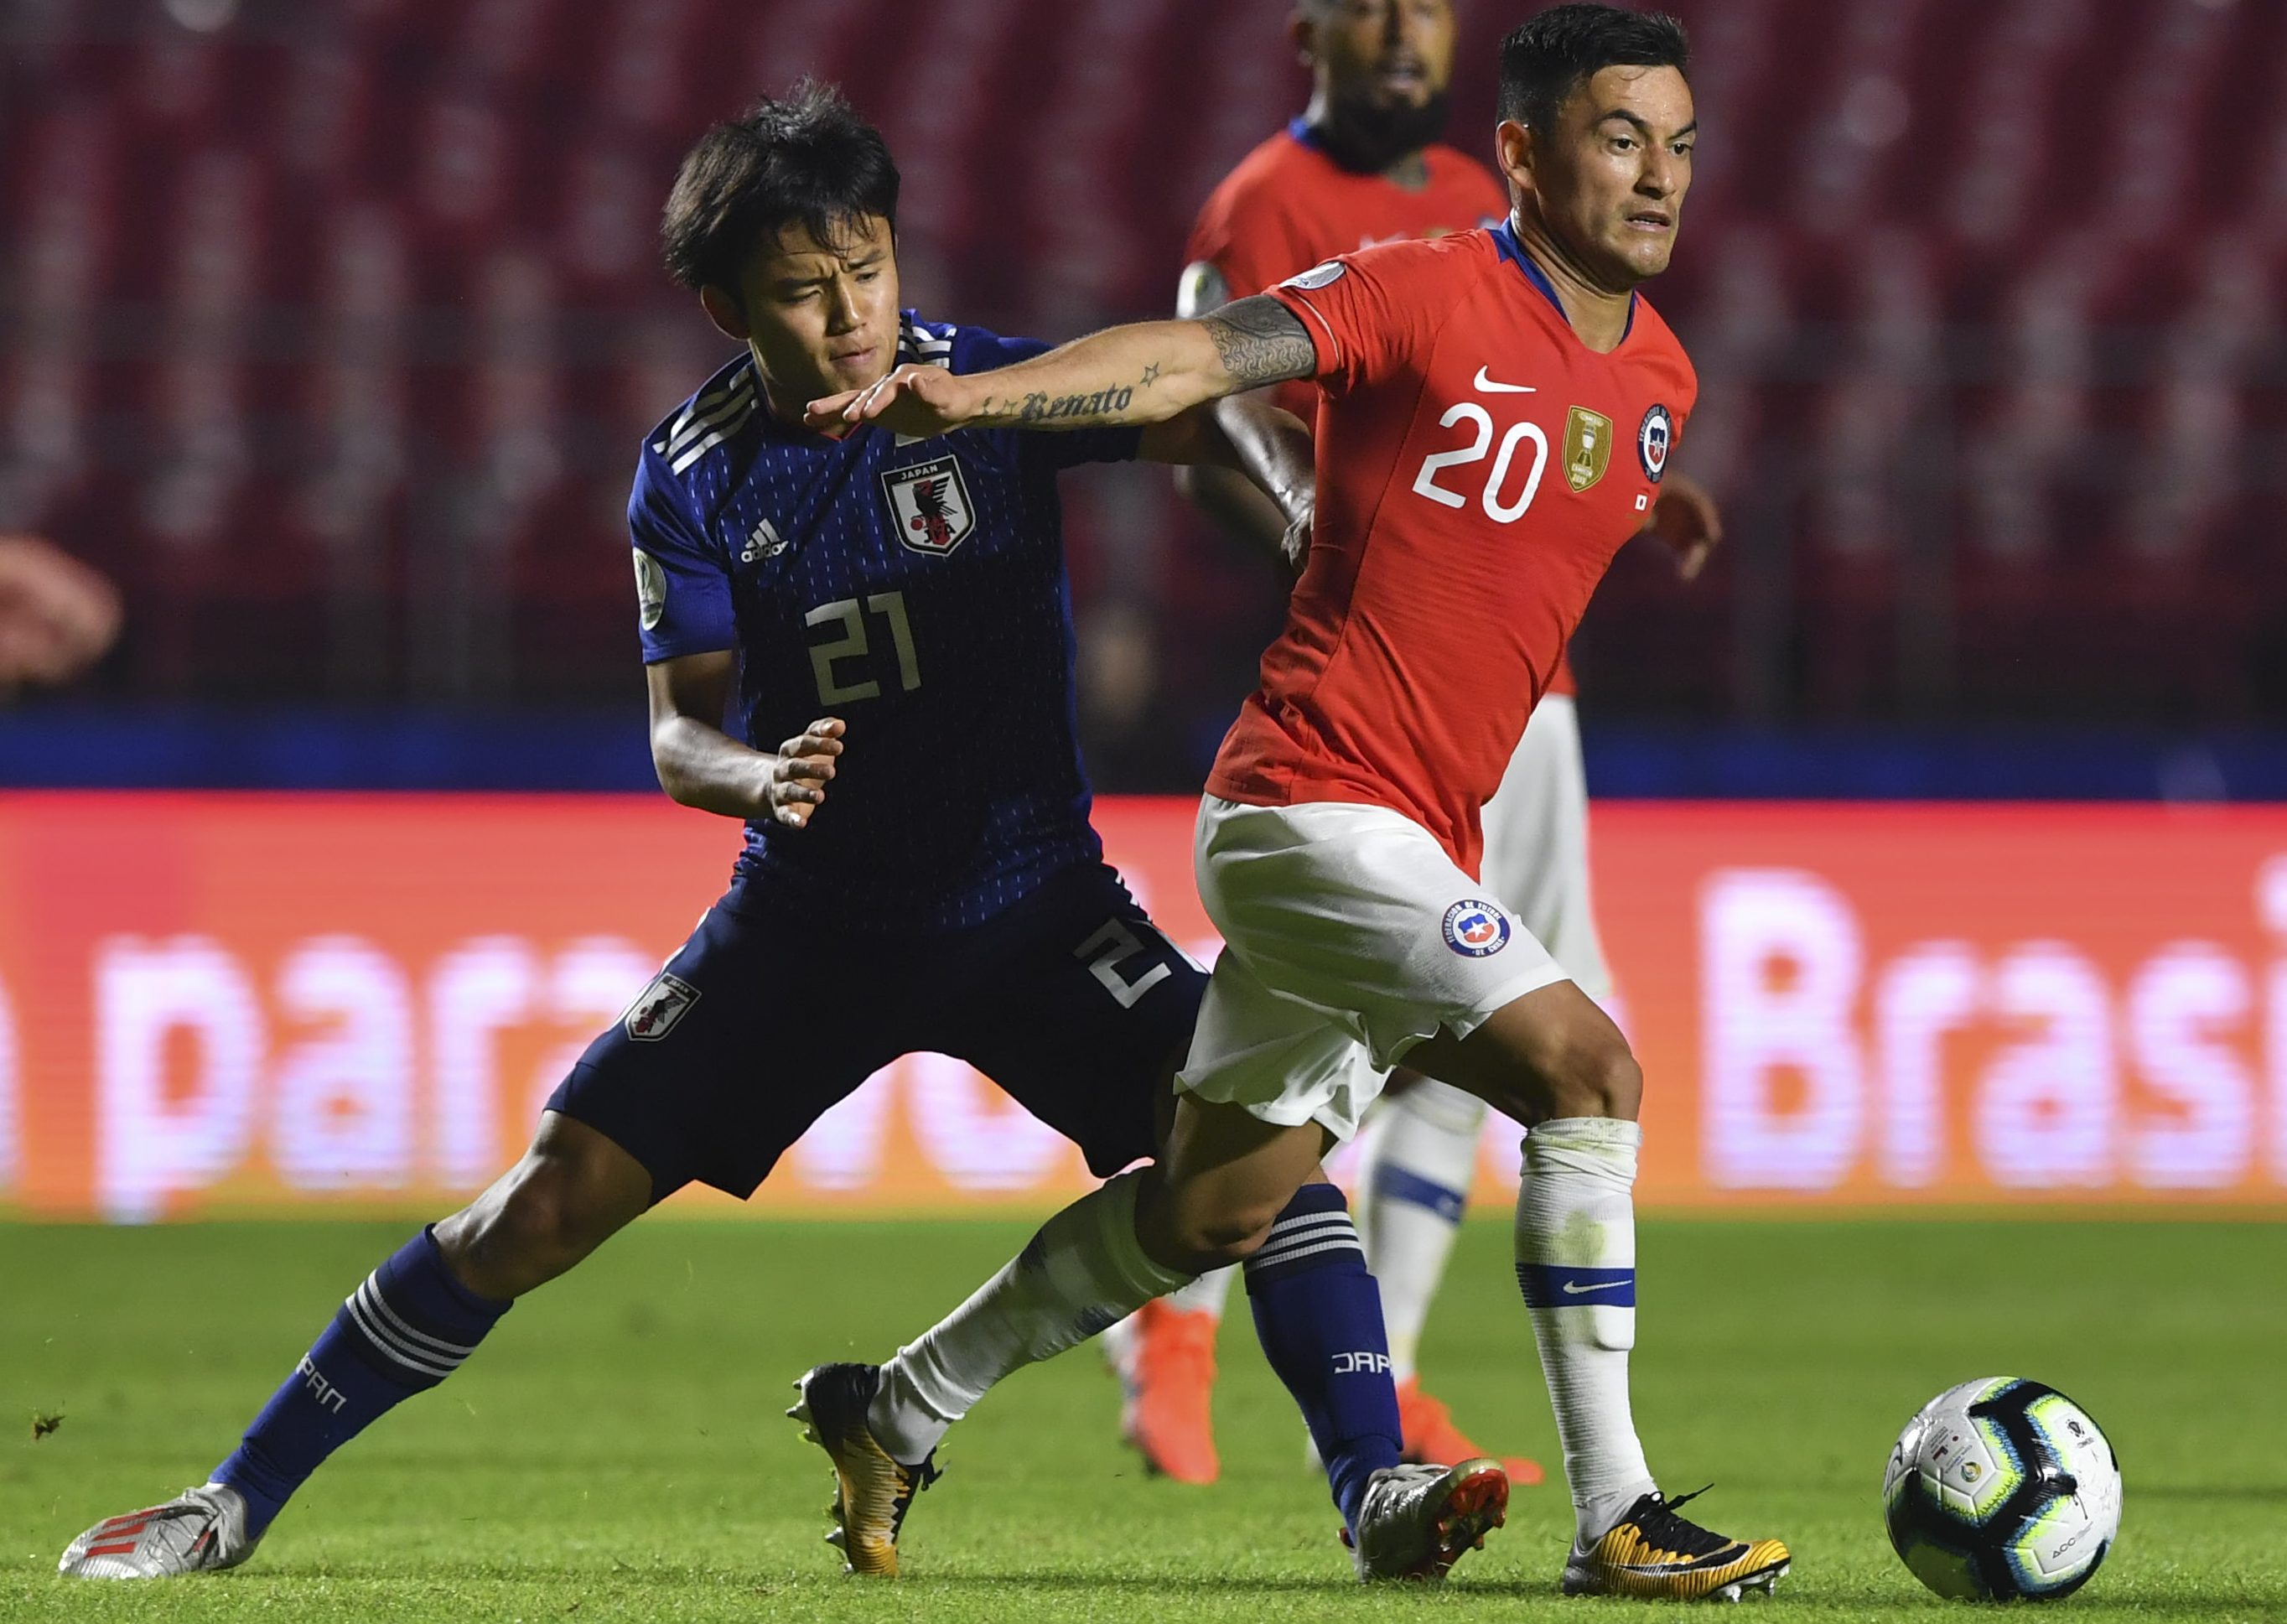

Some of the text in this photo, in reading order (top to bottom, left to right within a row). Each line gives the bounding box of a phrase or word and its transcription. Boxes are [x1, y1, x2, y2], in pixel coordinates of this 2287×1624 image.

[1021, 382, 1133, 420] Renato
[900, 464, 939, 481] JAPAN
[1412, 402, 1548, 523] 20
[740, 541, 789, 563] adidas
[805, 590, 921, 707] 21
[1331, 1351, 1393, 1378] JAP
